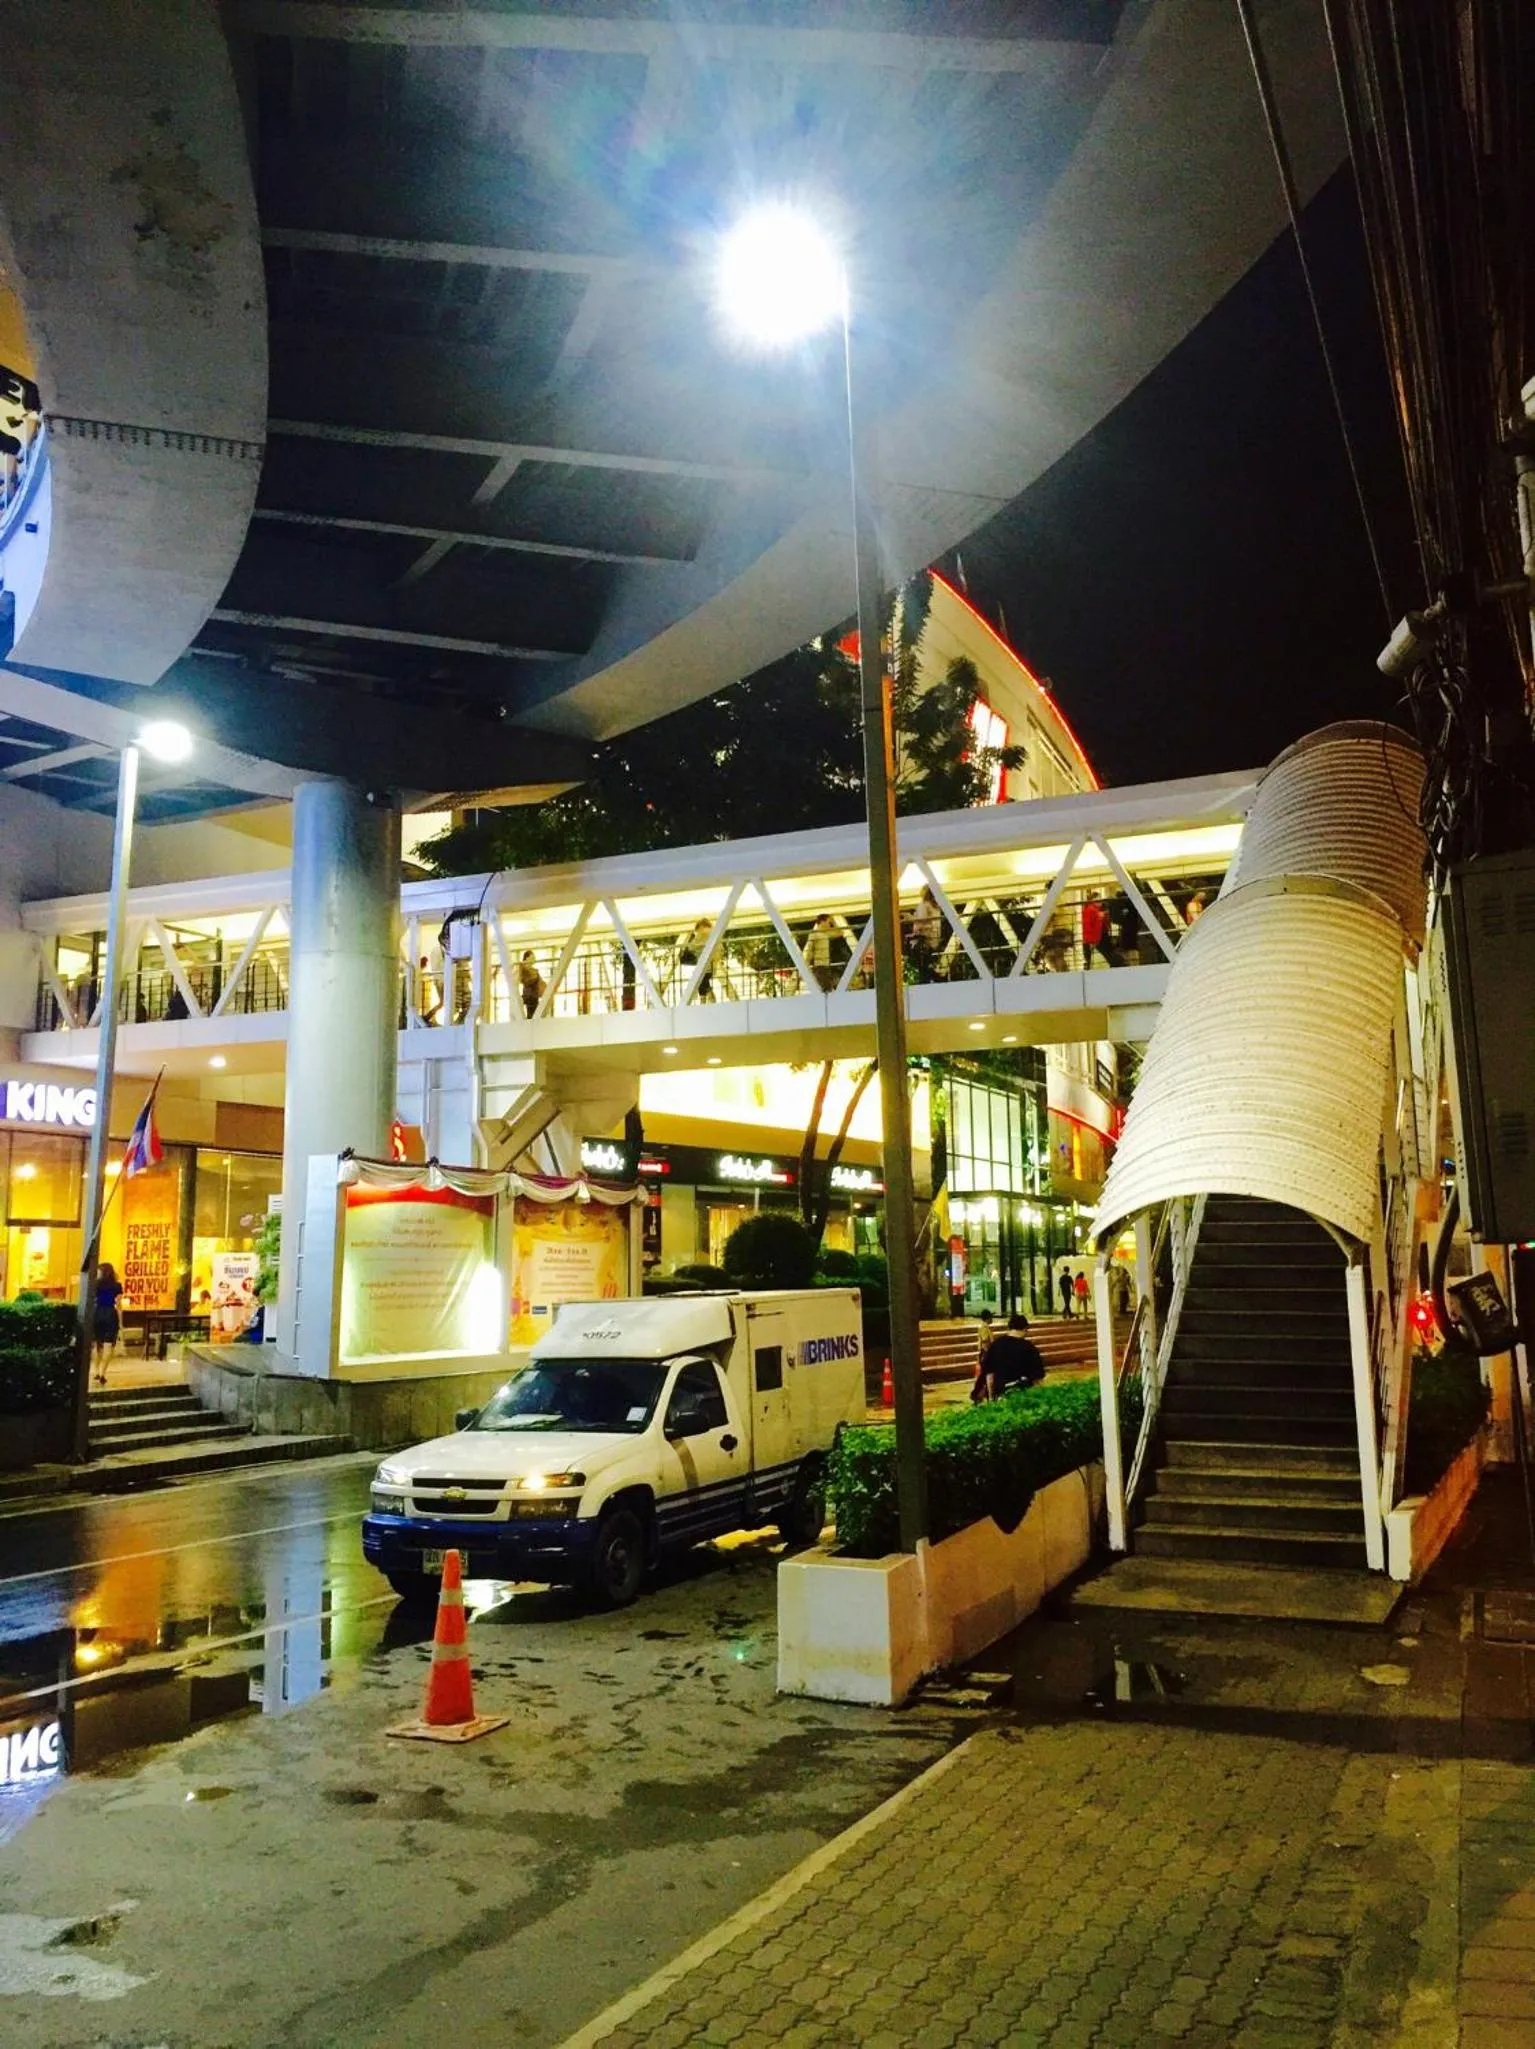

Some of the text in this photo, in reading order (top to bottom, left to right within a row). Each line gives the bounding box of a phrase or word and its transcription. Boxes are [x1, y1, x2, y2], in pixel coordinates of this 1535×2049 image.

[6, 1081, 97, 1126] KING
[128, 1224, 170, 1239] FRESHLY
[126, 1240, 170, 1260] FLAME
[125, 1260, 169, 1277] GRILLED
[125, 1278, 168, 1294] FOR YOU
[807, 1334, 859, 1365] BRINKS
